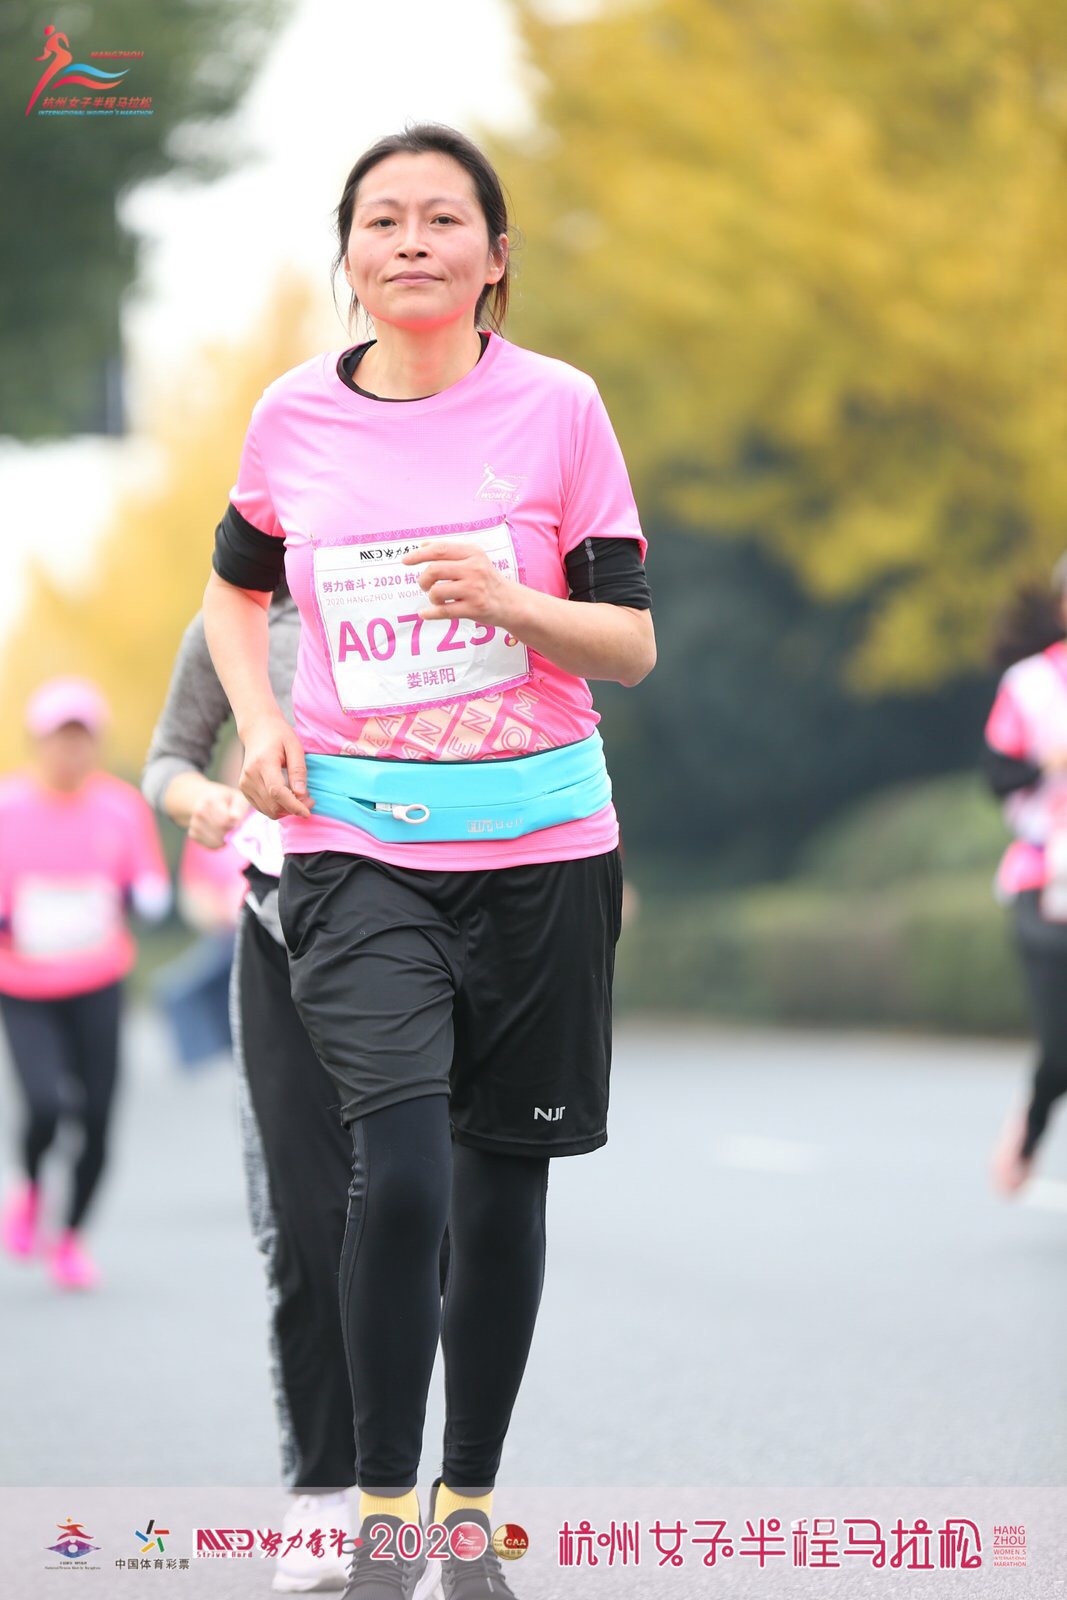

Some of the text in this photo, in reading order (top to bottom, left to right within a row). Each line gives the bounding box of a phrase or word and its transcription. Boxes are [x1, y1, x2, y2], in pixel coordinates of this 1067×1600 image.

[327, 588, 430, 606] 2020 HANGZHOU WOME
[407, 667, 456, 689] 娄晓阳
